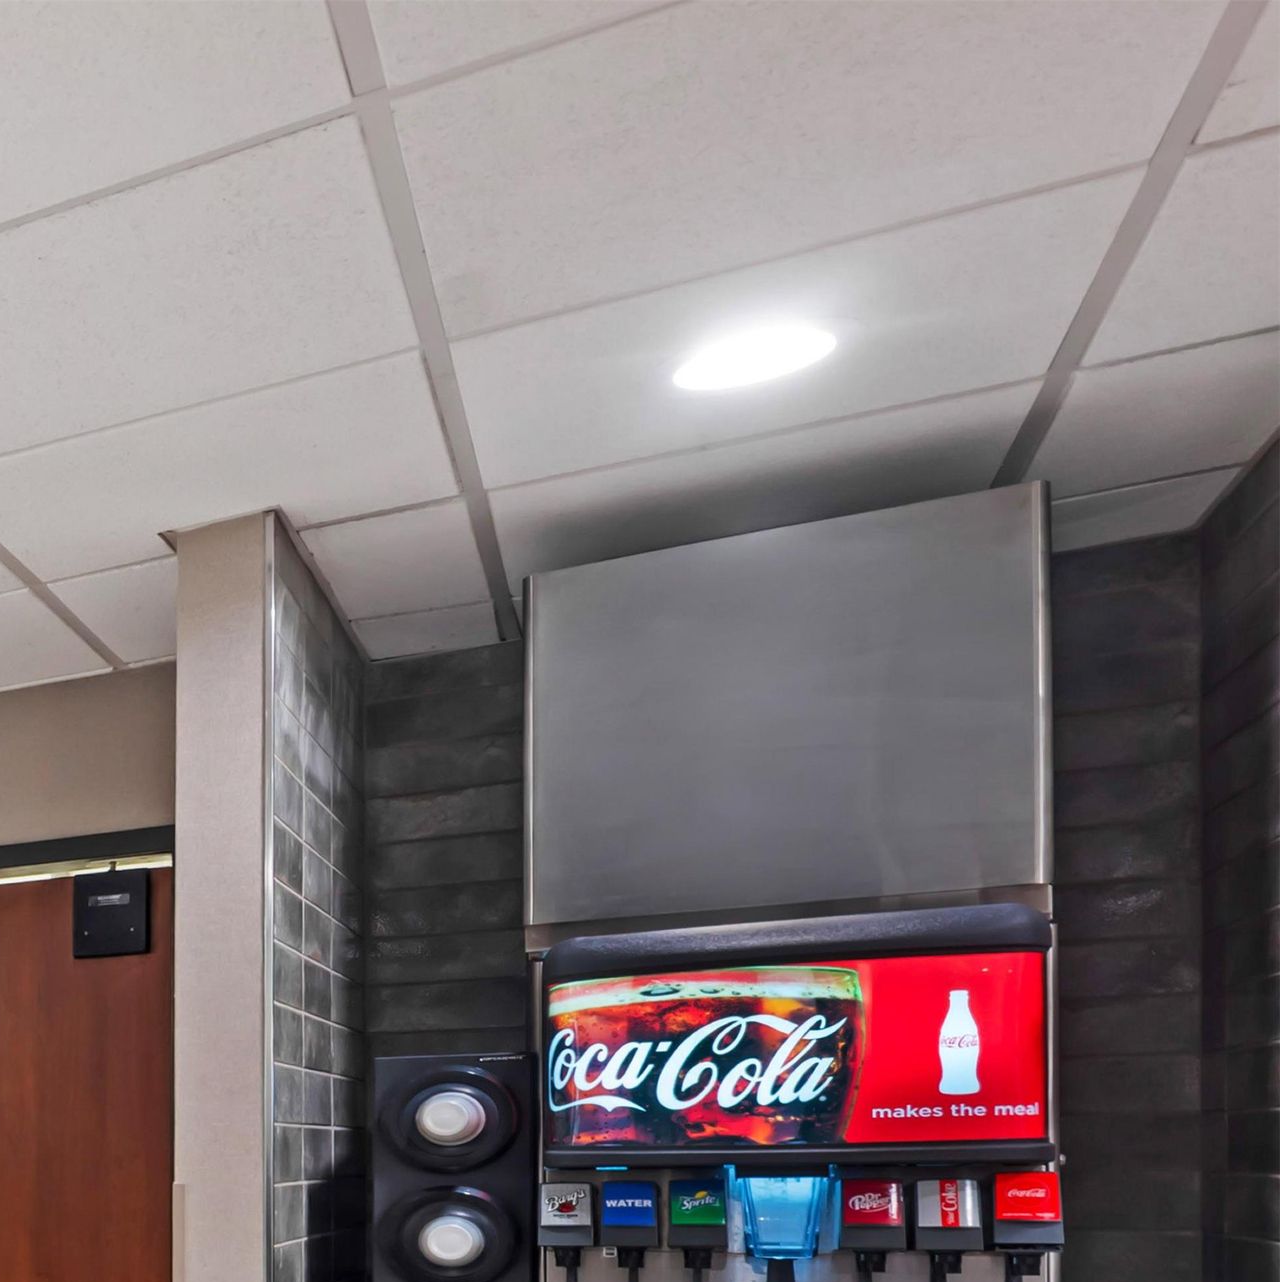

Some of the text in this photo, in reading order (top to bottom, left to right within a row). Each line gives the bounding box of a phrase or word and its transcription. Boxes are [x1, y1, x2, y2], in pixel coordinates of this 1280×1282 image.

[547, 1014, 848, 1112] Coca-Cola
[871, 1102, 1040, 1119] makes the meal
[605, 1199, 653, 1208] WATER
[681, 1195, 717, 1211] Sprite
[941, 1183, 958, 1211] Coke
